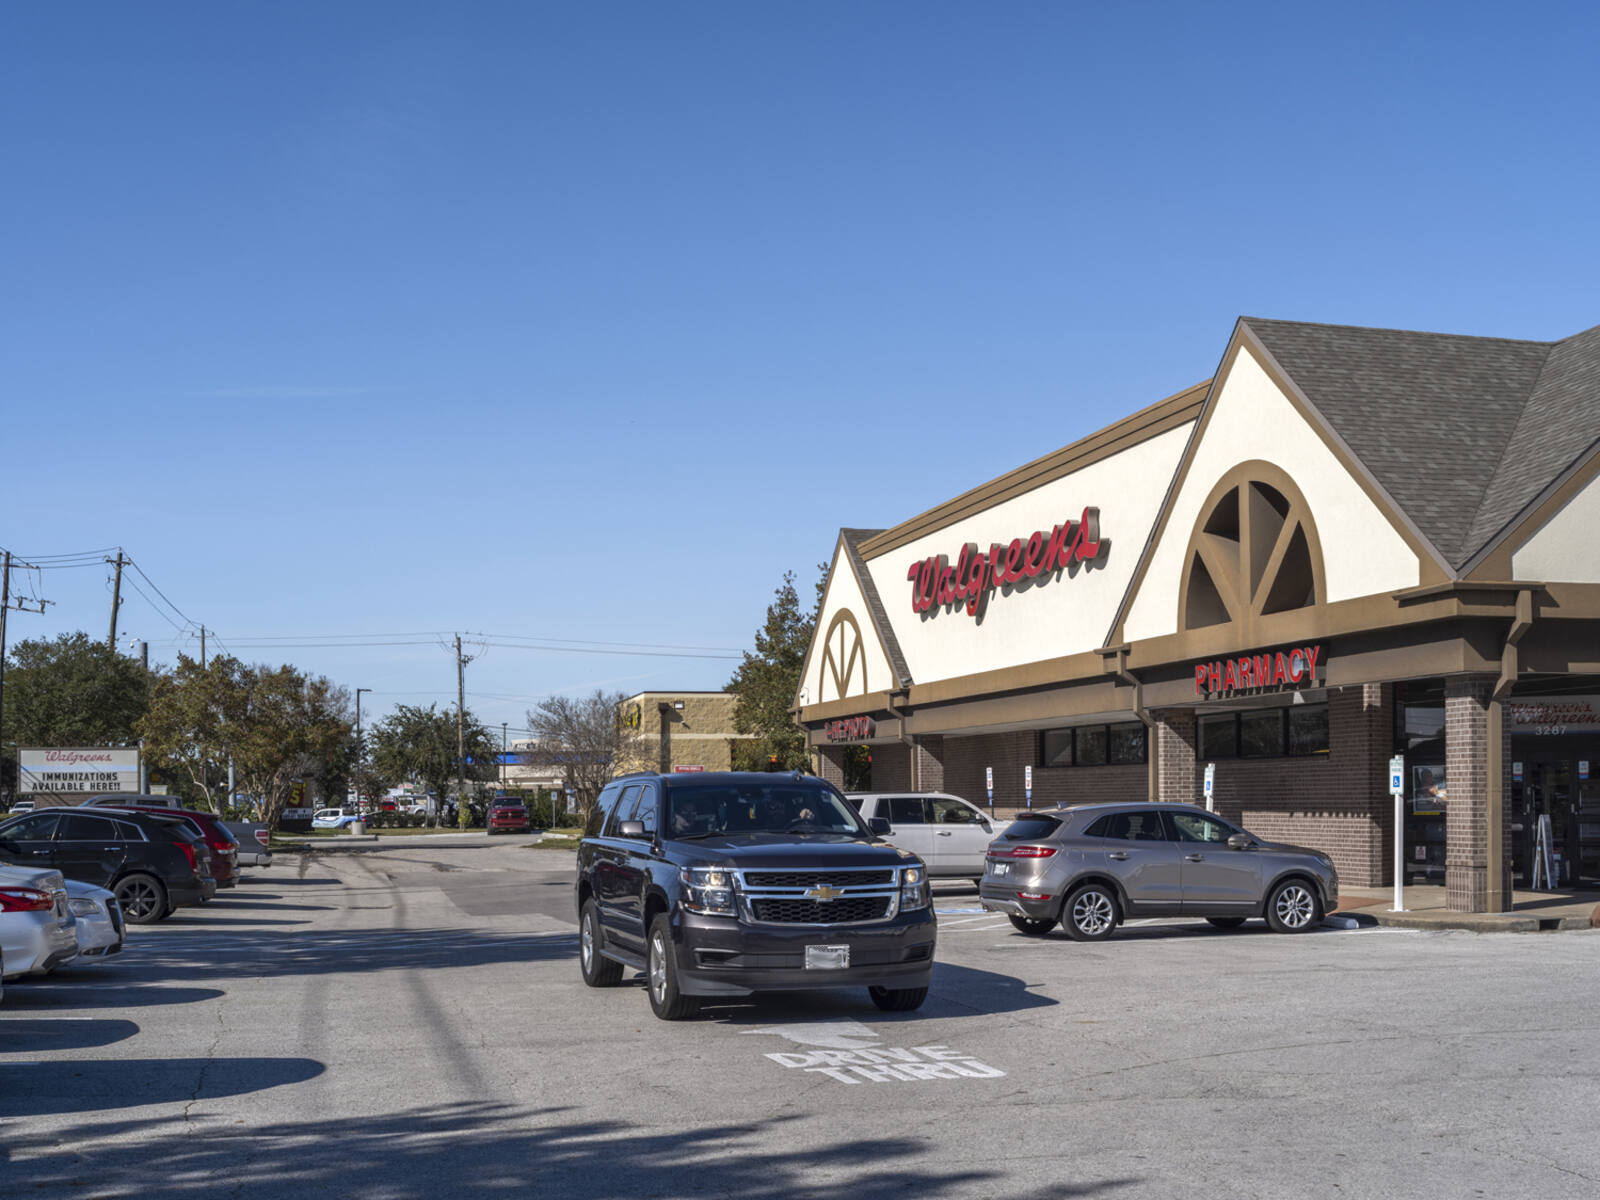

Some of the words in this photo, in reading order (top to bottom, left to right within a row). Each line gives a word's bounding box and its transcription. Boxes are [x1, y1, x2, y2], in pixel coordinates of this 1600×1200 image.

[907, 506, 1101, 616] Walgreens
[1195, 645, 1320, 695] PHARMACY
[844, 715, 870, 737] PHOTO
[1535, 725, 1567, 735] 3287
[44, 750, 112, 765] Walgreens
[32, 782, 85, 791] AVAILABLE
[90, 782, 121, 791] HERE!!
[42, 772, 118, 781] IMMUNIZATIONS
[763, 1046, 976, 1069] DRIVE
[803, 1060, 1007, 1084] THRU
